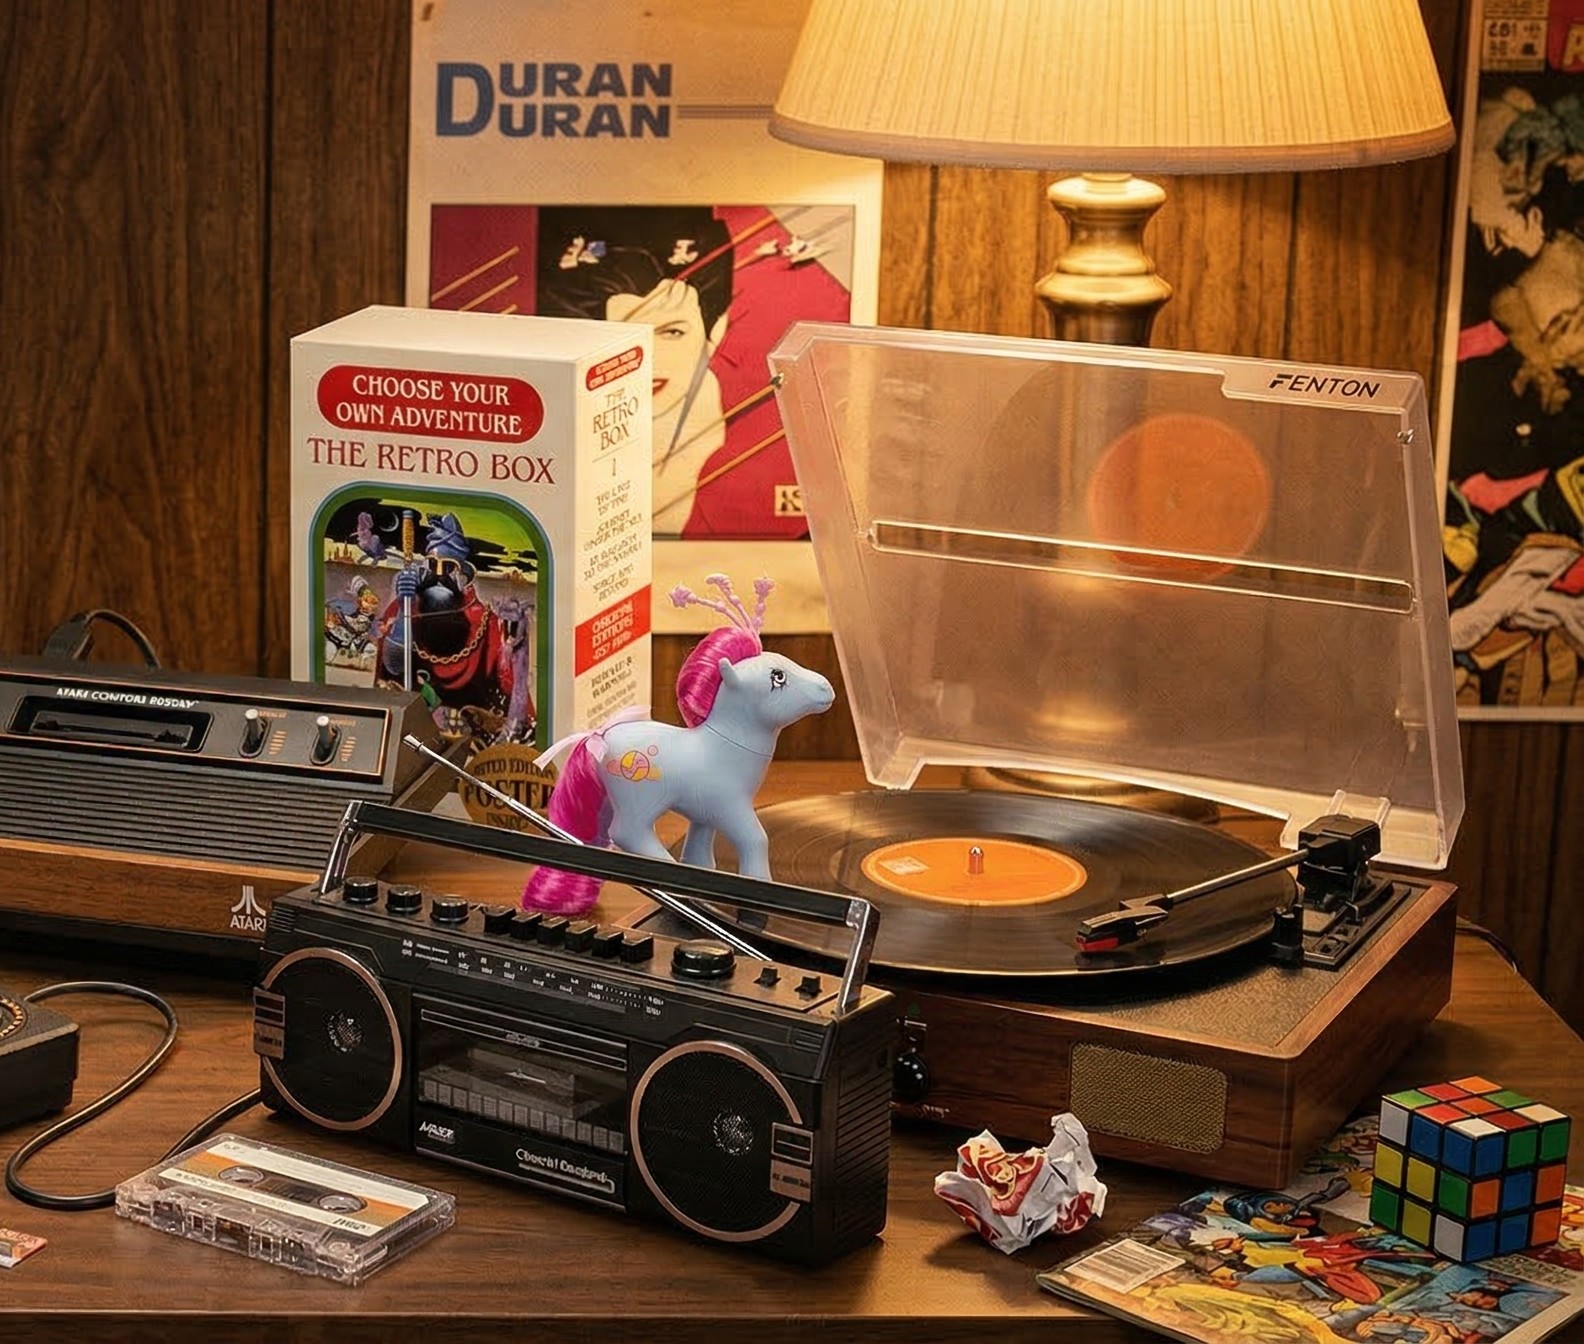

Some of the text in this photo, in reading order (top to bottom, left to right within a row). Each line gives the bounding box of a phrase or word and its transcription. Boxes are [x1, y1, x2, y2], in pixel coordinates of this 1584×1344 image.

[352, 374, 510, 406] CHOOSE YOUR
[1269, 373, 1380, 398] FENTON
[336, 402, 522, 436] OWN ADVENTURE
[306, 437, 555, 485] THE RETRO BOX
[229, 915, 266, 932] ATARI
